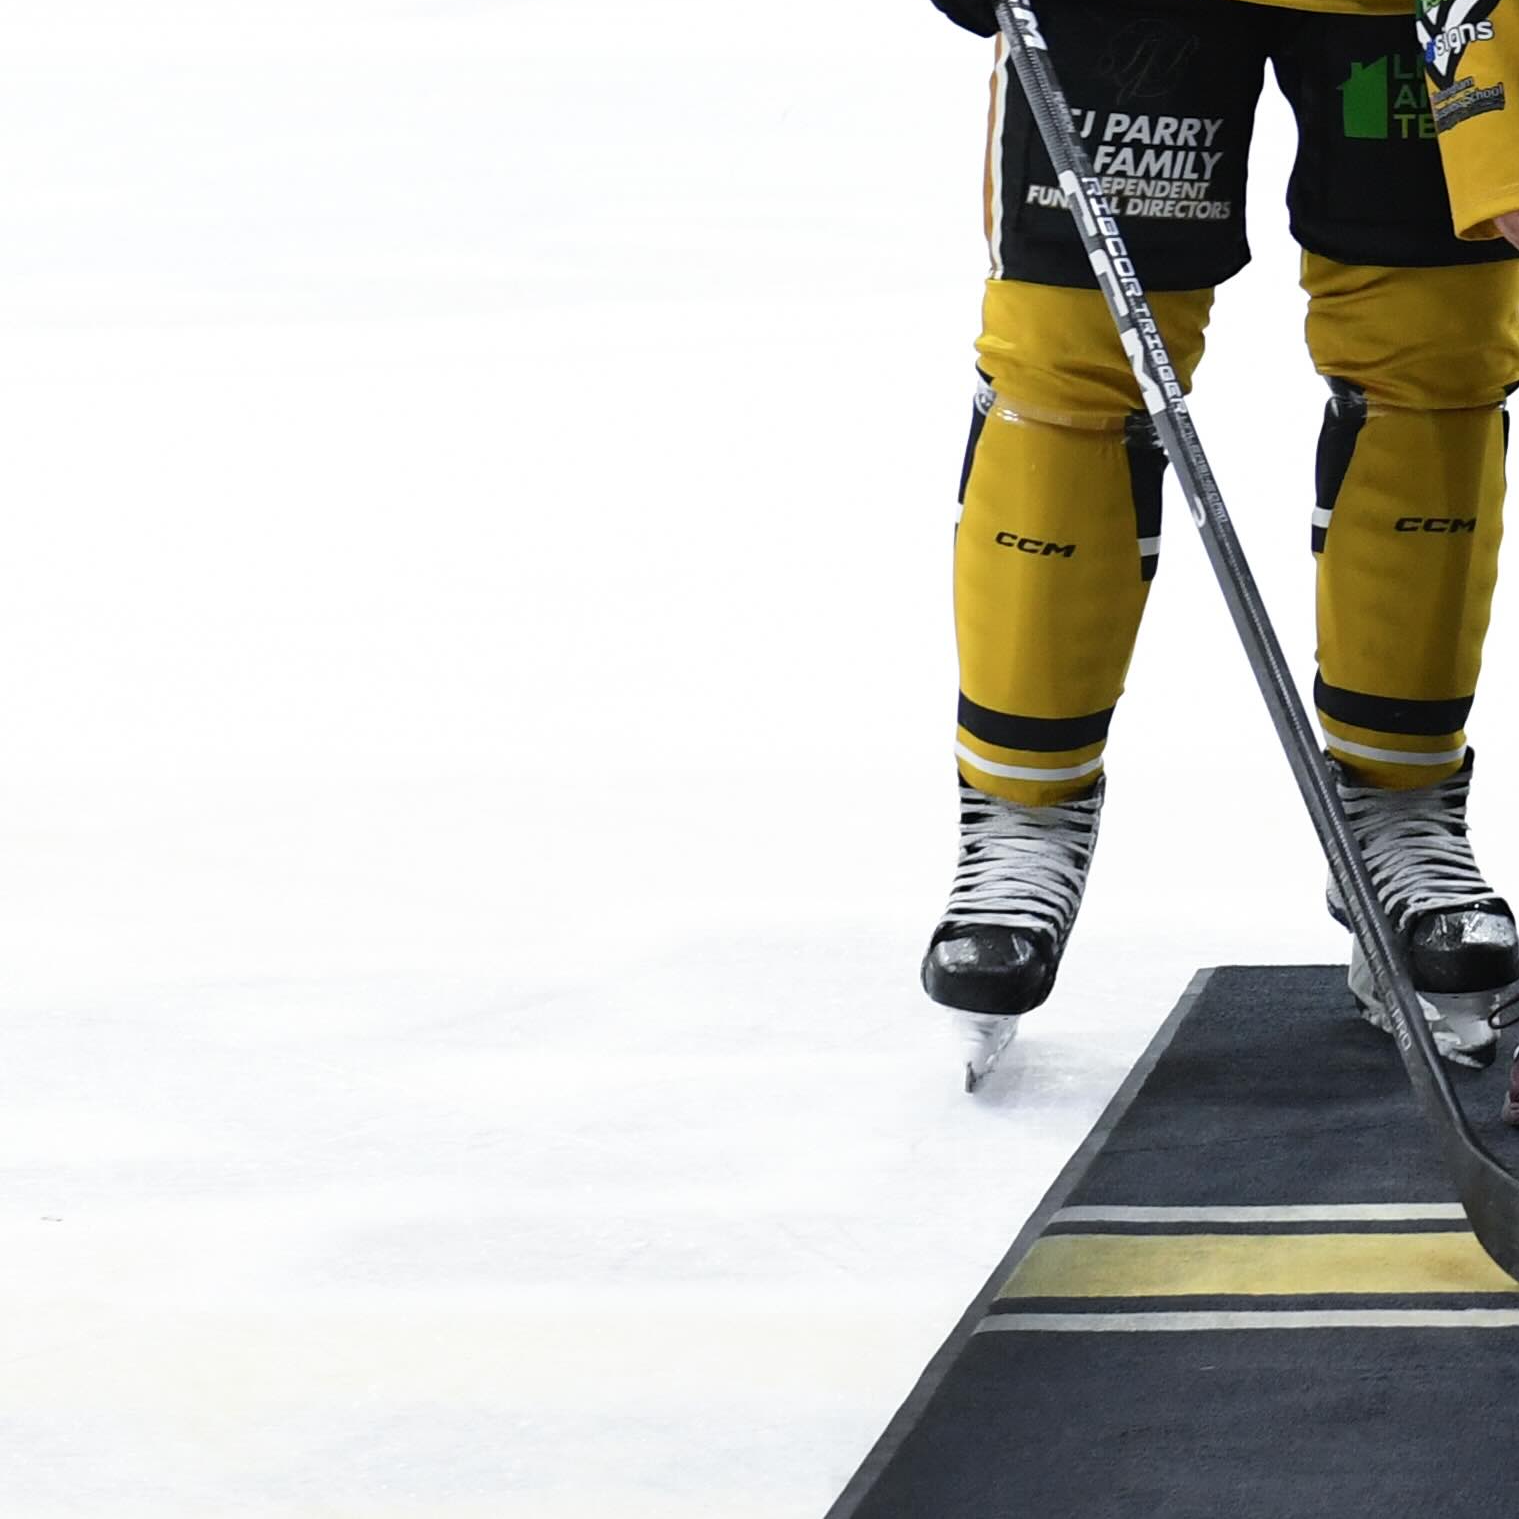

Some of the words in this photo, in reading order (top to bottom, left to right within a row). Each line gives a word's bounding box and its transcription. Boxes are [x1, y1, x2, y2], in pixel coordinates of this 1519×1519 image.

[1103, 112, 1224, 148] PARRY
[1092, 144, 1224, 181] FAMILY
[1098, 176, 1210, 200] EPENDENT
[1125, 197, 1232, 221] DIRECTORS
[1080, 175, 1144, 299] RIBCOR
[1394, 515, 1477, 534] CCM
[994, 531, 1077, 558] CCM
